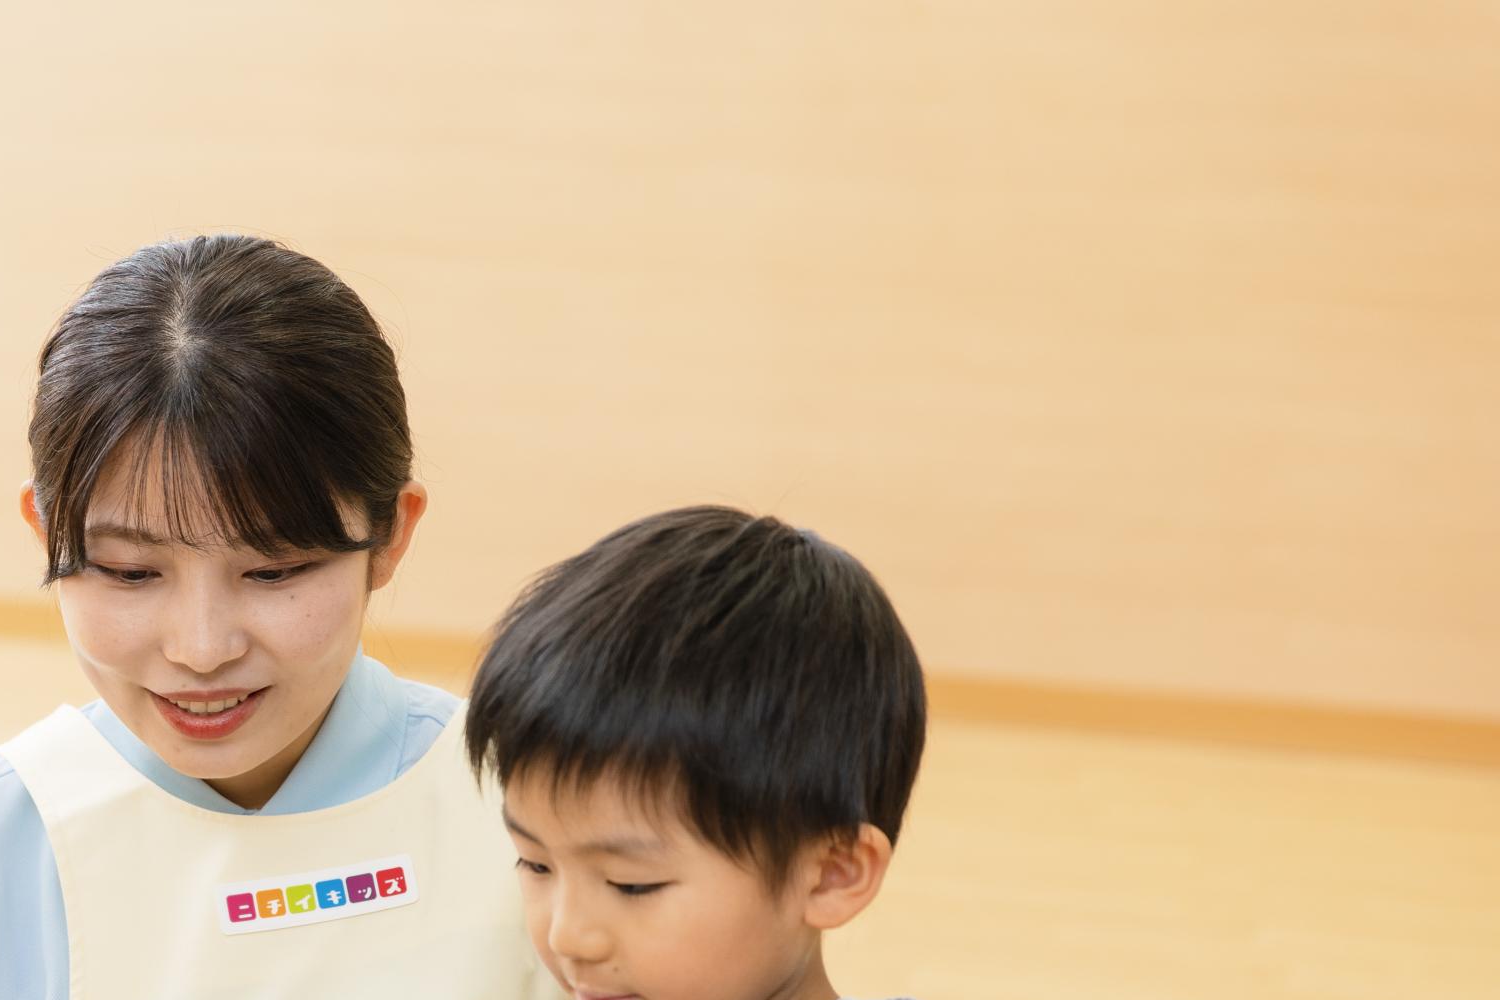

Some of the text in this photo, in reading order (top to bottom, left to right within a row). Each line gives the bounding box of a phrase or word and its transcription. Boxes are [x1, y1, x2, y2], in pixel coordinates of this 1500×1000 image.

[237, 876, 404, 919] ニチイキッズ
